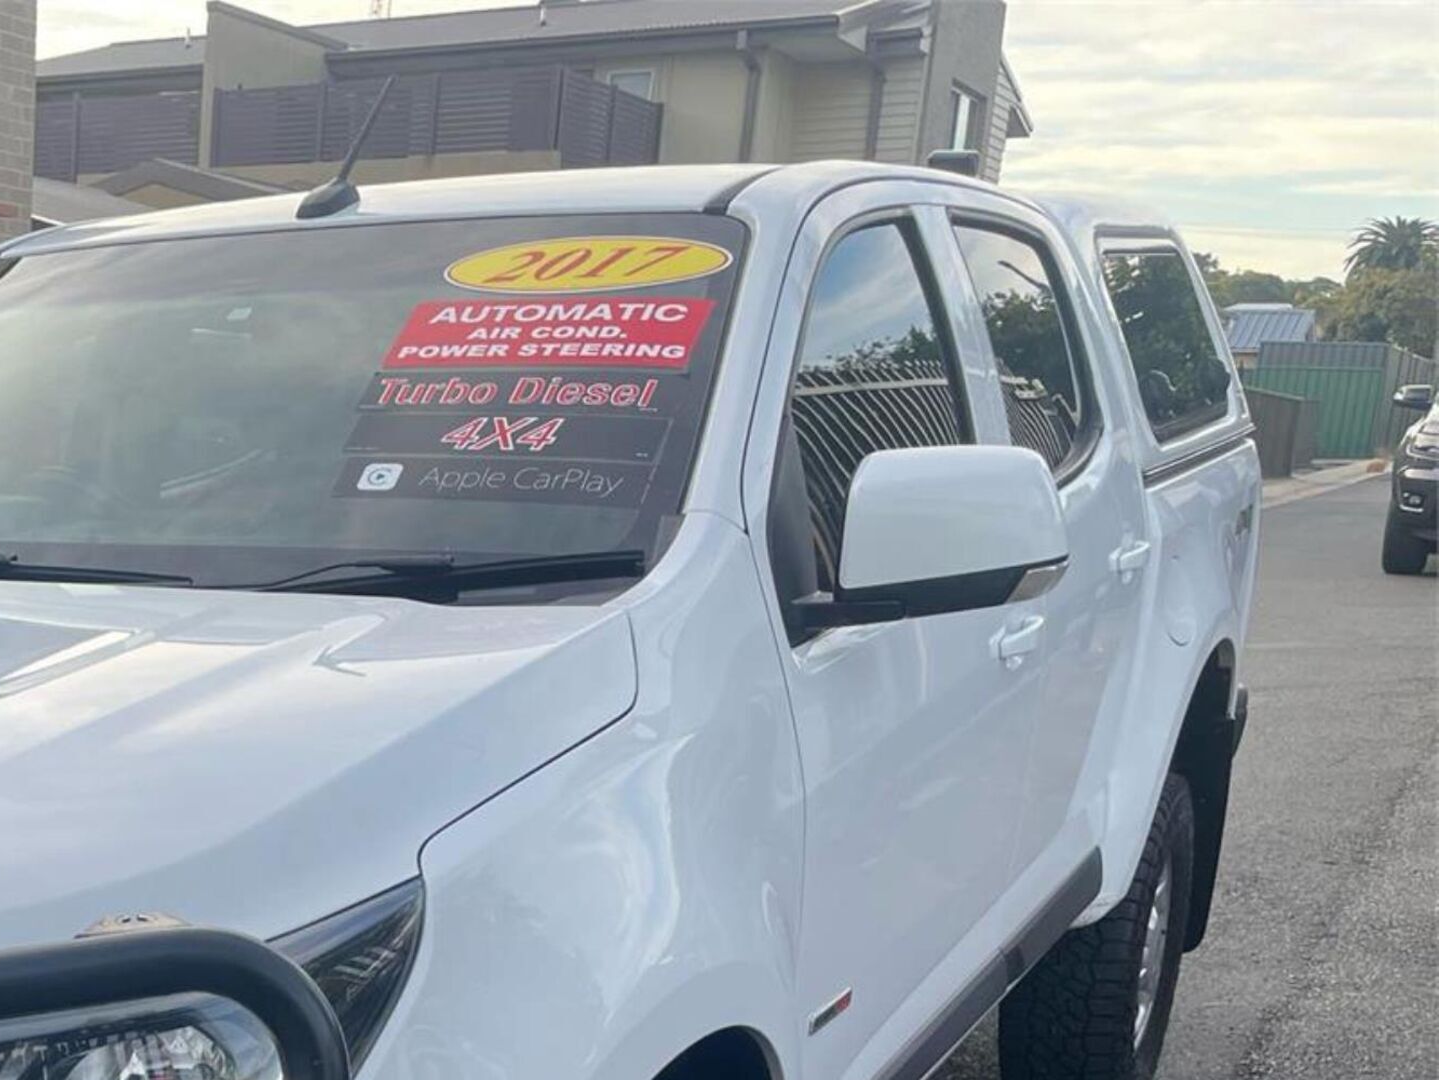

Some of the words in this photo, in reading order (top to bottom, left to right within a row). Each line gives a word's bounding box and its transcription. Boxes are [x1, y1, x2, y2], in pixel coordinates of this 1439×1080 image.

[482, 245, 691, 283] 2017
[429, 303, 688, 324] AUTOMATIC
[467, 326, 522, 340] AIR
[530, 326, 628, 339] COND.
[397, 343, 510, 359] POWER
[517, 342, 686, 359] STEERING
[377, 377, 498, 406] Turbo
[509, 376, 658, 408] Diesel
[440, 416, 565, 451] 4X4
[417, 466, 506, 493] Apple
[513, 467, 625, 499] CarPlay
